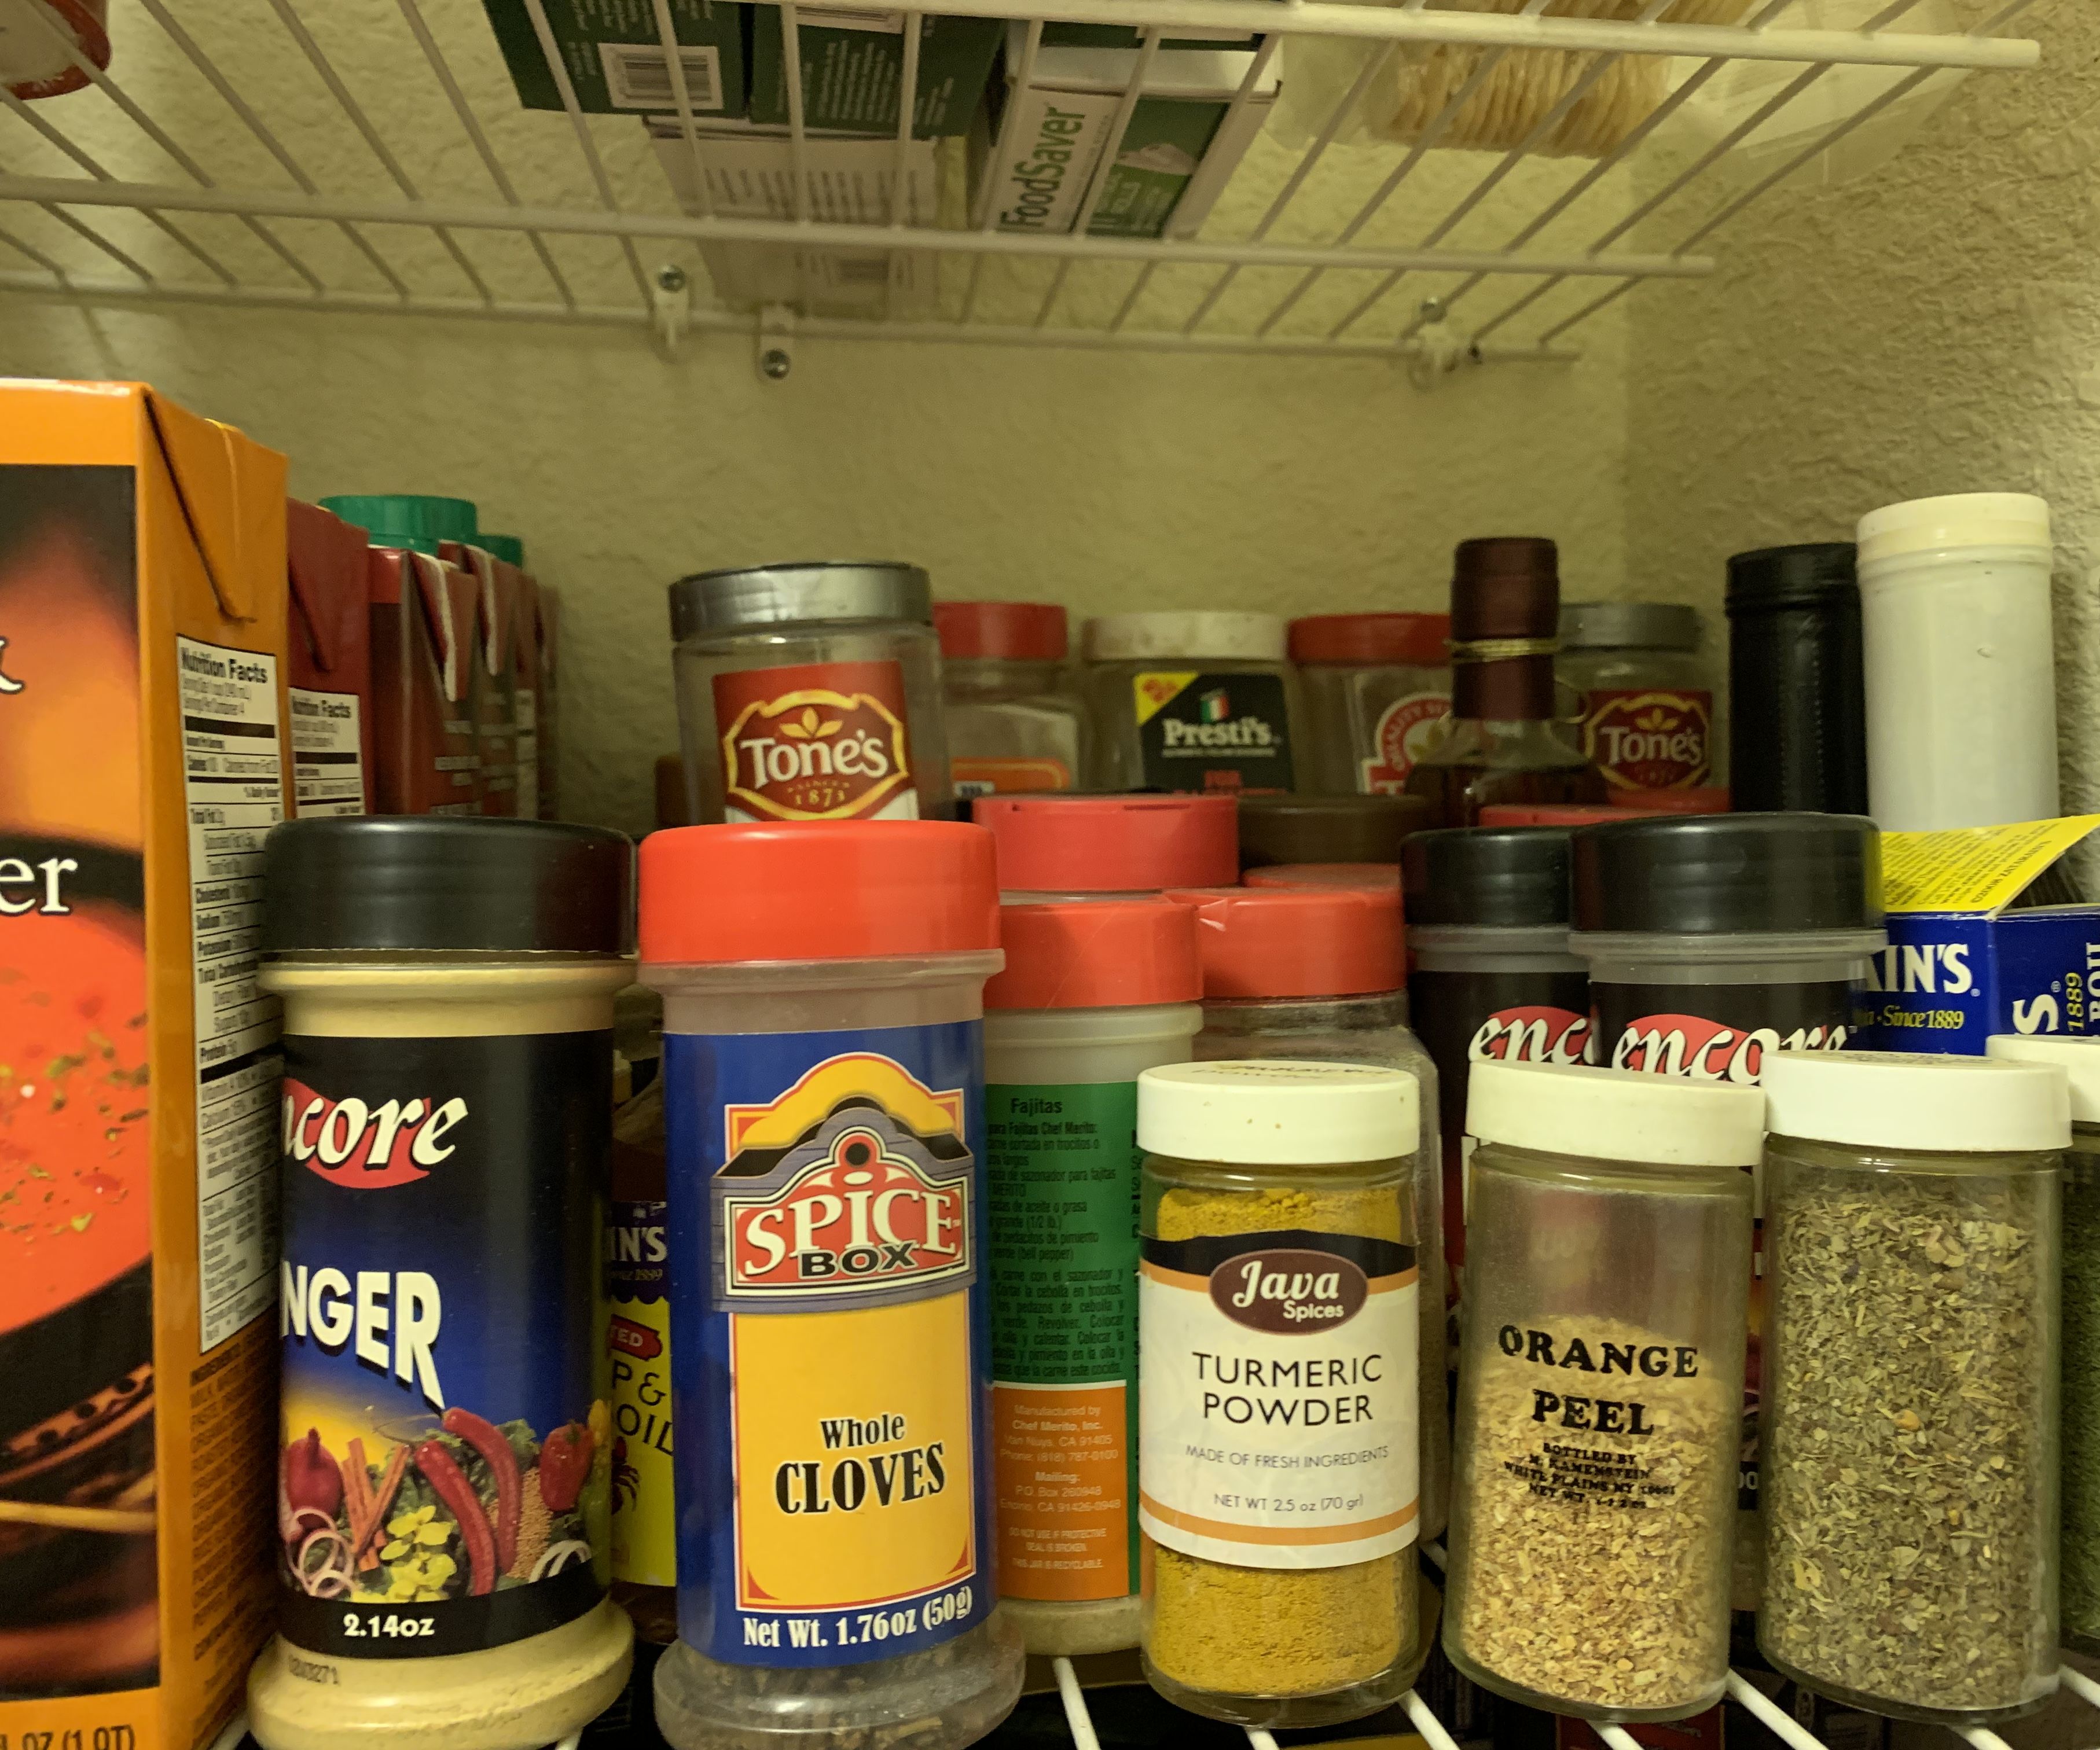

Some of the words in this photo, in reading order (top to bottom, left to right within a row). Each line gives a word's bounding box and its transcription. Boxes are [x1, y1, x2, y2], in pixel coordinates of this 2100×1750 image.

[1000, 105, 1086, 229] FoodSaver
[229, 659, 268, 683] Facts
[321, 700, 351, 719] Facts
[740, 729, 889, 789] Tone's
[1599, 727, 1702, 767] Tone's
[0, 855, 78, 915] er
[1882, 1005, 1926, 1028] Since
[1926, 1010, 1965, 1030] 1889
[2065, 972, 2084, 1032] 1889
[1011, 1098, 1063, 1117] Fajitas
[799, 1242, 919, 1279] BOX
[1232, 1260, 1340, 1308] Java
[1283, 1301, 1344, 1323] Spices
[1498, 1324, 1699, 1378] ORANGE
[611, 1359, 633, 1389] P
[638, 1372, 667, 1407] &
[1191, 1351, 1382, 1388] TURMERIC
[1012, 1420, 1038, 1431] Chef
[1014, 1405, 1085, 1417] Manufactured
[1088, 1406, 1100, 1417] by
[1203, 1392, 1374, 1426] POWDER
[1531, 1388, 1654, 1436] PEEL
[820, 1414, 905, 1449] Whole
[1185, 1444, 1224, 1464] MADE
[1228, 1452, 1251, 1466] OF
[1255, 1454, 1299, 1468] FRESH
[1304, 1446, 1389, 1468] INGREDIENTS
[1543, 1442, 1612, 1463] BOTTLED
[1617, 1453, 1637, 1465] BY
[775, 1442, 945, 1514] CLOVES
[1503, 1461, 1547, 1481] WHITE
[1551, 1472, 1608, 1492] PLAINS
[1529, 1482, 1556, 1498] NET
[1213, 1493, 1241, 1509] NET
[1244, 1497, 1268, 1510] WT
[1274, 1498, 1296, 1512] 2.5
[1299, 1501, 1316, 1512] oz
[343, 1613, 435, 1638] 2.14oz
[743, 1617, 780, 1648] Net
[787, 1619, 829, 1648] Wt.
[922, 1586, 973, 1631] (50g)
